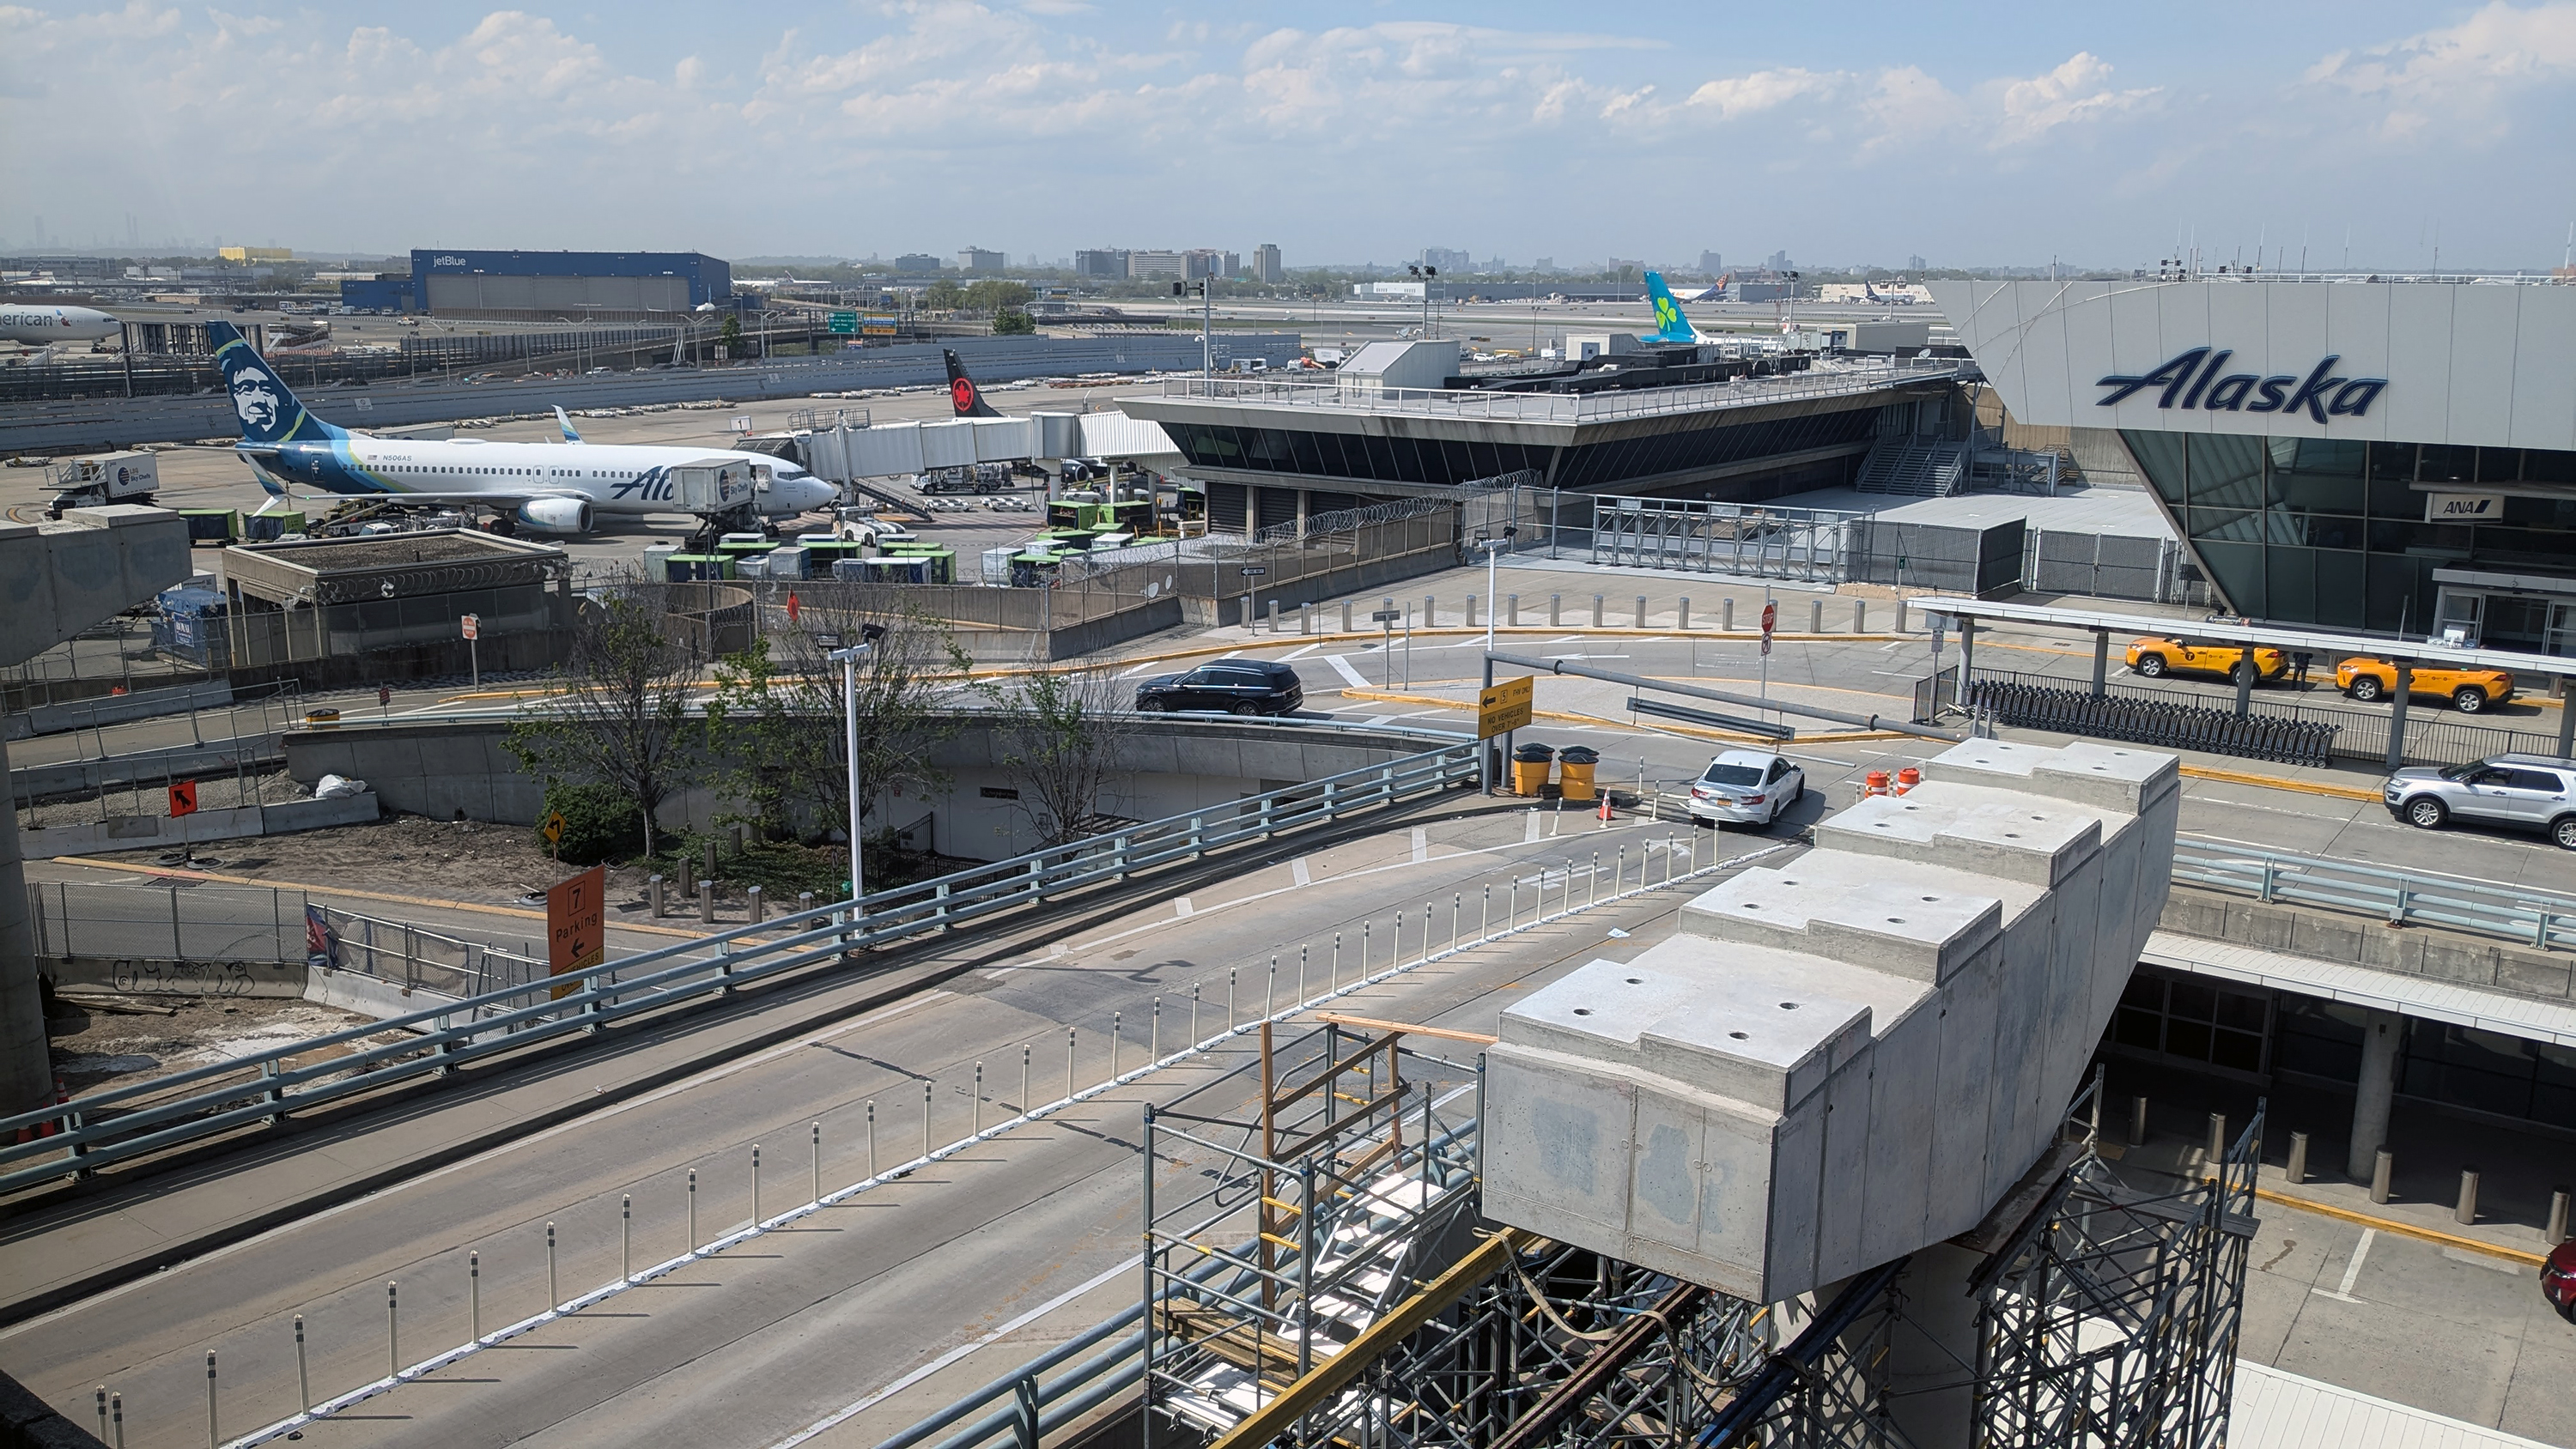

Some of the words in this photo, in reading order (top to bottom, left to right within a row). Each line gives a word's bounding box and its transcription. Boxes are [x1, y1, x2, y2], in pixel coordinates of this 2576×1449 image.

[433, 255, 466, 268] jetBlue
[0, 311, 52, 327] erican
[2094, 346, 2390, 425] Alaska
[738, 482, 749, 493] Chefs
[2443, 500, 2474, 514] ANA
[1762, 612, 1774, 626] STOP
[1487, 715, 1496, 725] NO
[1498, 707, 1524, 722] VEHICLES
[1491, 723, 1505, 733] OVER
[572, 887, 581, 910] 7
[556, 912, 598, 943] Parking
